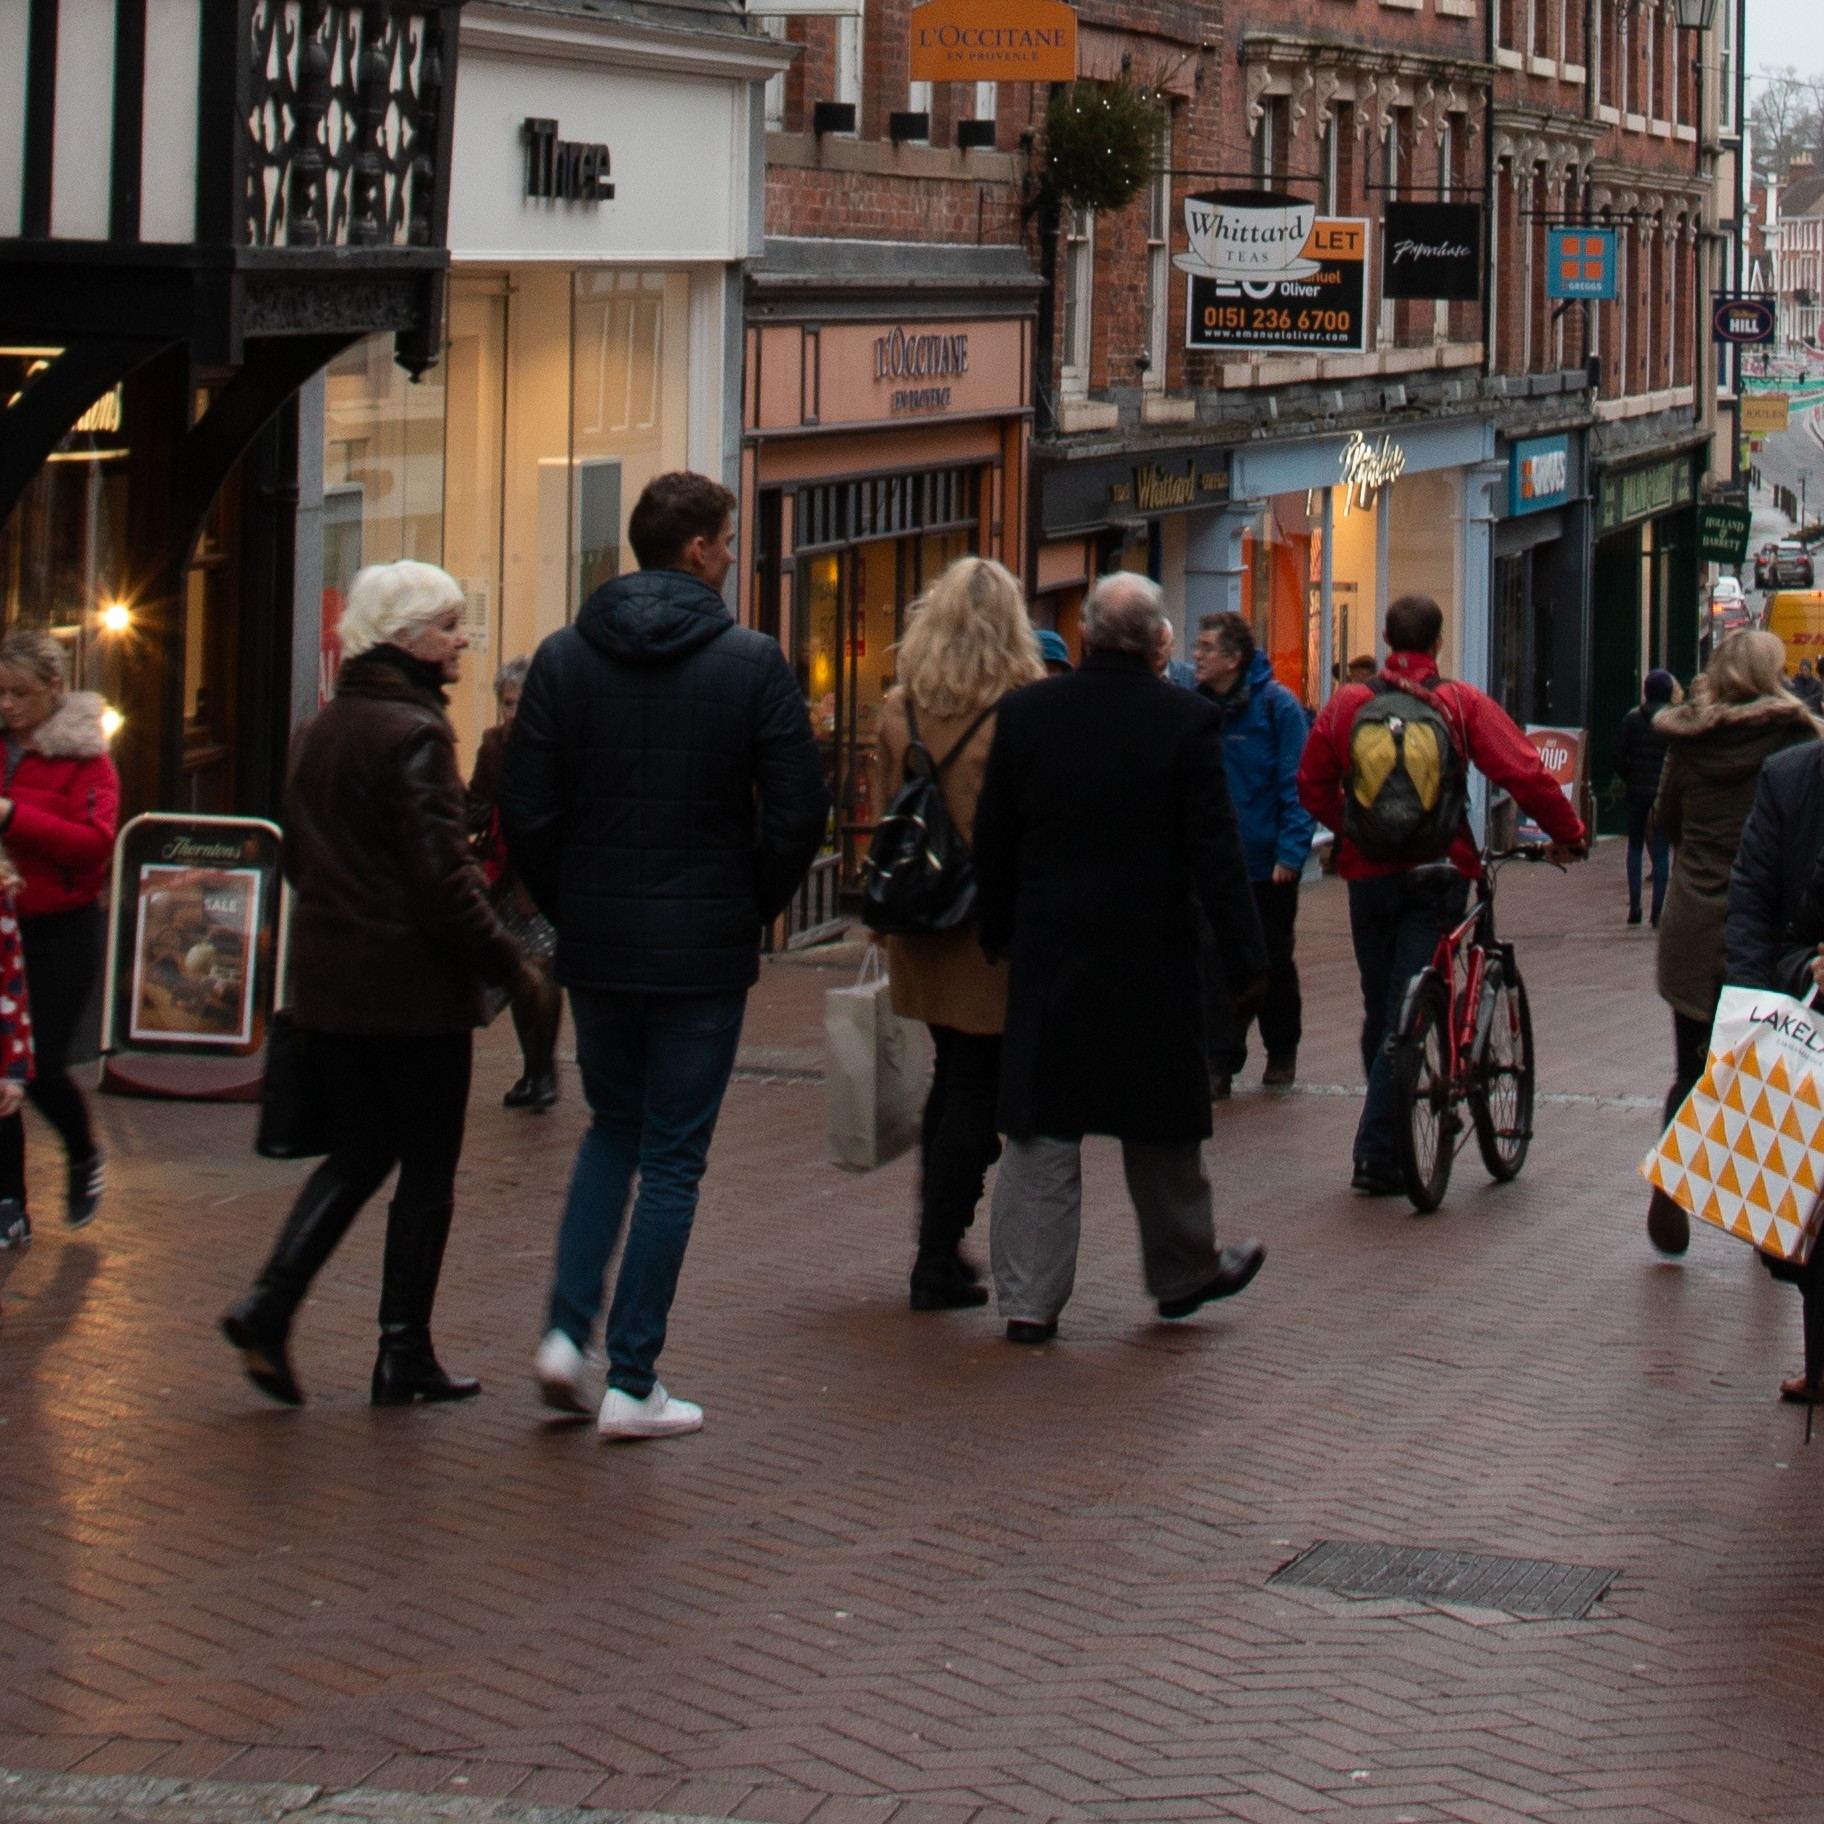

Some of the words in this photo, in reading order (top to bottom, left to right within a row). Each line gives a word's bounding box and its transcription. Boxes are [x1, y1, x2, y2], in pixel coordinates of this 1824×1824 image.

[918, 23, 1067, 49] L'OCCITANE
[520, 117, 615, 201] Three
[1190, 211, 1306, 244] Whittard
[1314, 230, 1360, 251] LET
[1226, 250, 1270, 263] TEAS
[1279, 281, 1322, 298] Oliver
[1202, 305, 1247, 329] 0151
[1251, 307, 1292, 331] 236
[1296, 309, 1352, 333] 6700
[1728, 318, 1761, 335] HILL
[161, 835, 243, 860] Thorntons
[203, 897, 238, 913] SALE
